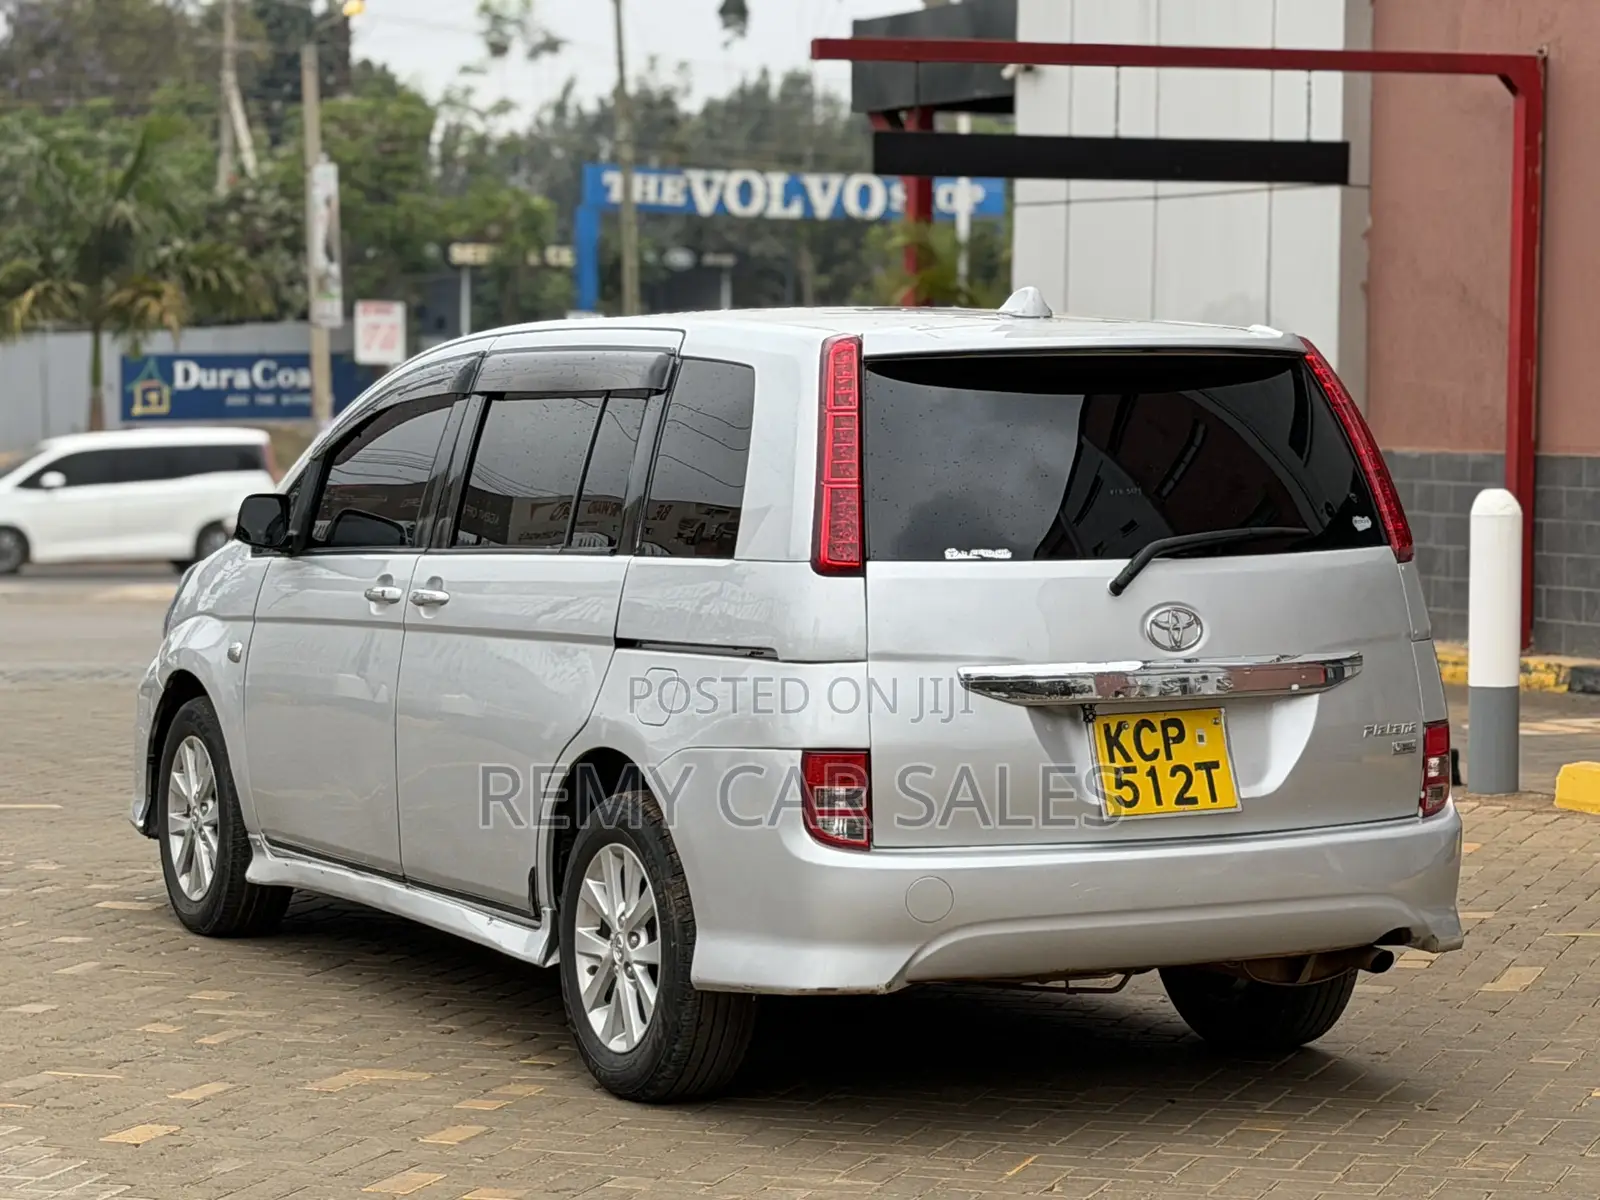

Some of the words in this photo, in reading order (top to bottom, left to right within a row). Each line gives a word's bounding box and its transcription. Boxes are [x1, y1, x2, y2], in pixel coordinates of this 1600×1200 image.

[602, 171, 687, 207] THE
[683, 169, 888, 221] VOLVO
[889, 183, 986, 214] SOP
[173, 359, 313, 391] DuraCoa
[1103, 718, 1186, 764] KCP
[1114, 760, 1220, 809] 512T
